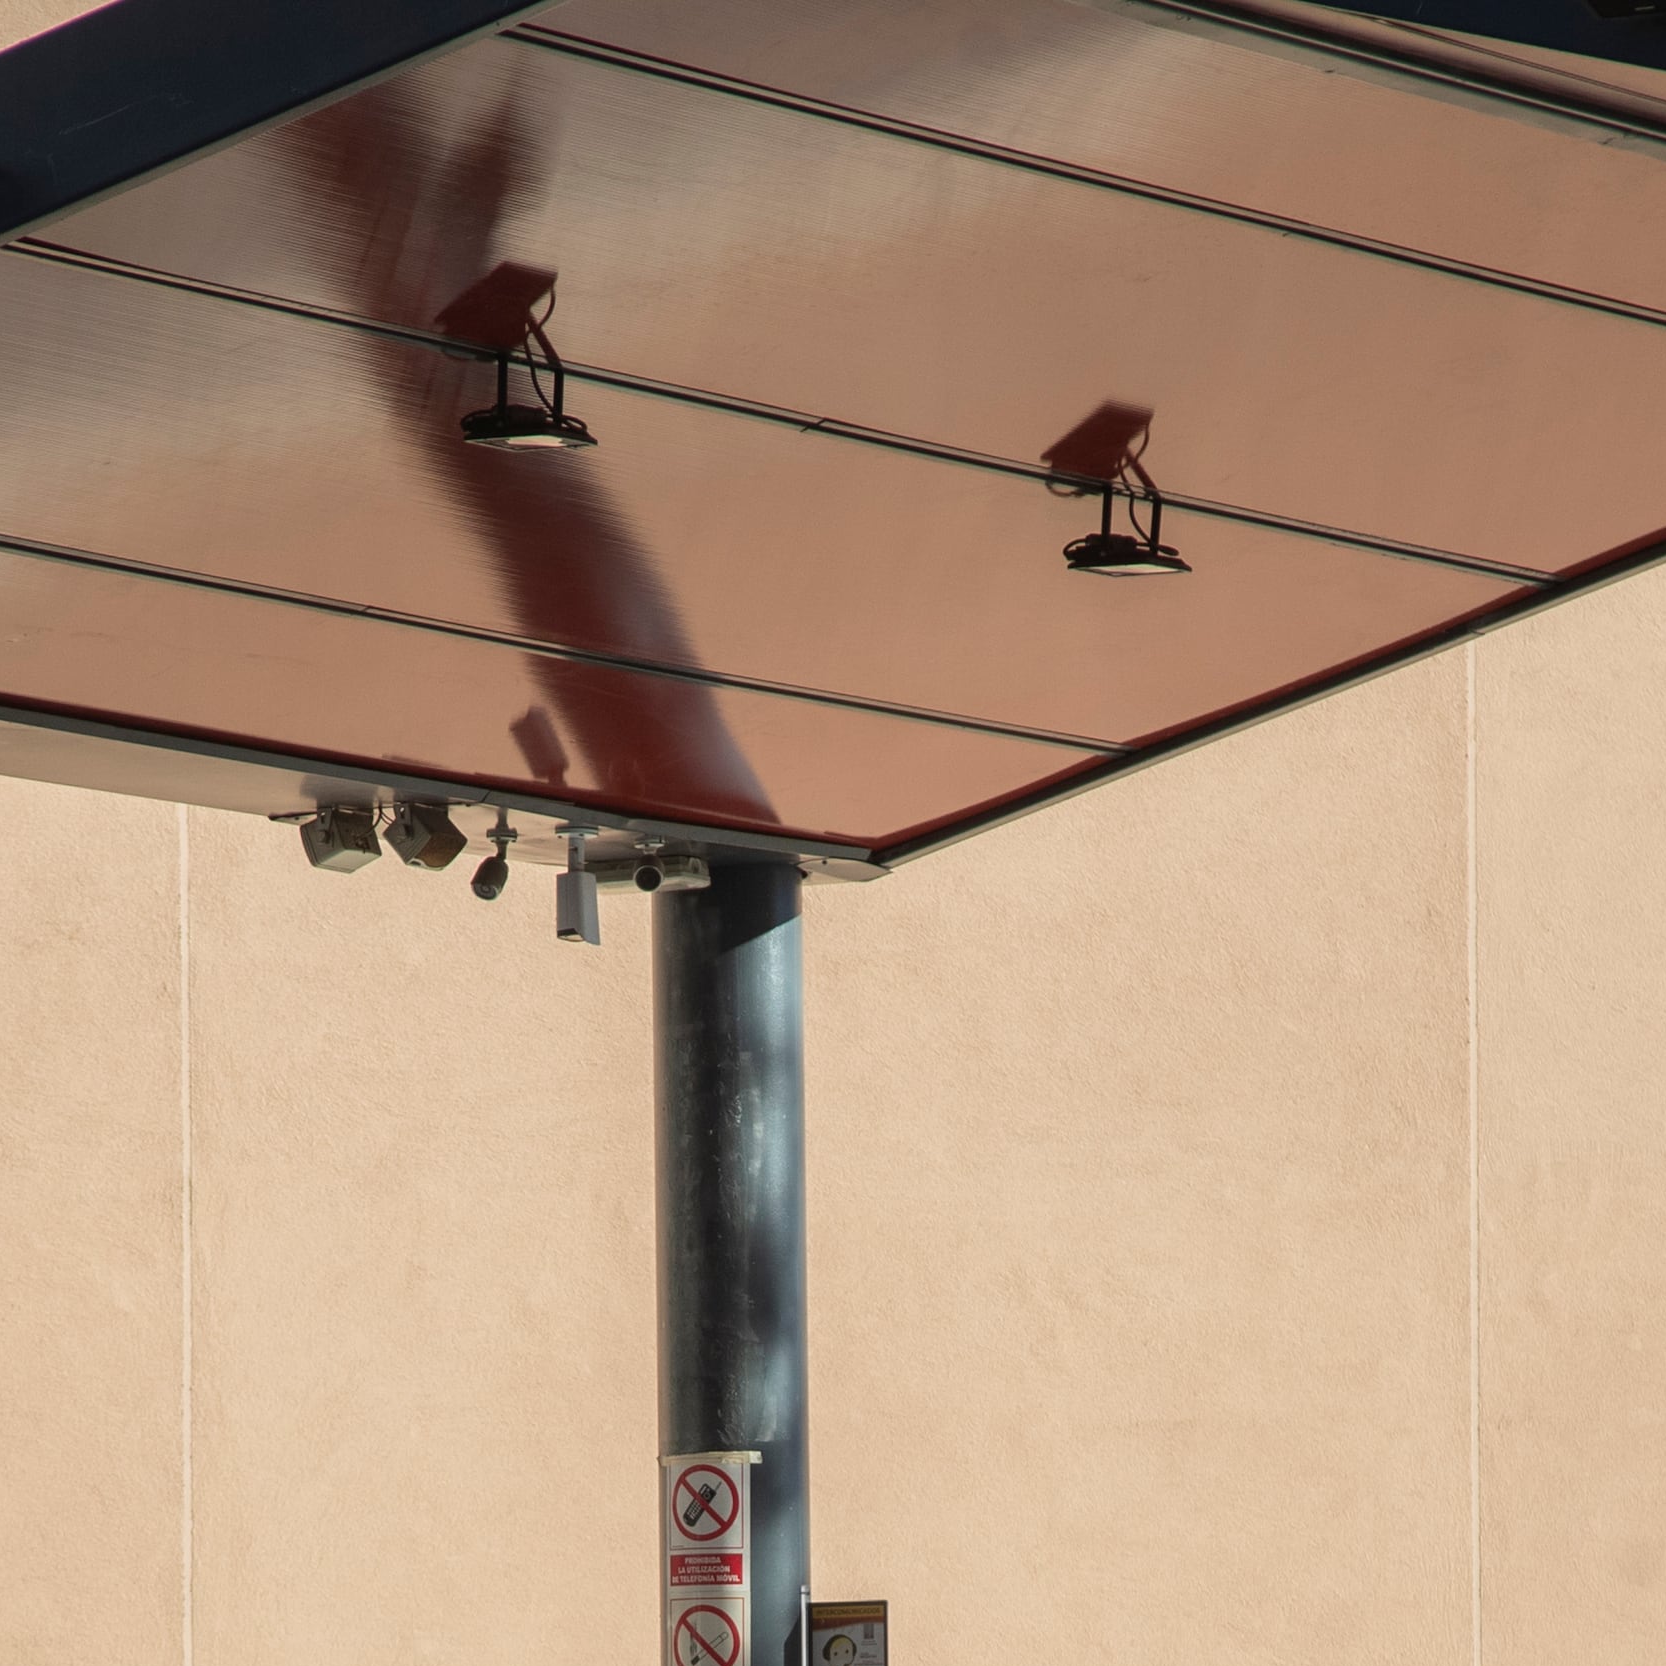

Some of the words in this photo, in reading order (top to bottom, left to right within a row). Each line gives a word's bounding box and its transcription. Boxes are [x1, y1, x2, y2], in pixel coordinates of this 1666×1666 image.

[685, 1556, 721, 1564] PROHIBIDA
[678, 1566, 686, 1574] LA
[717, 1573, 740, 1582] MÓVIL
